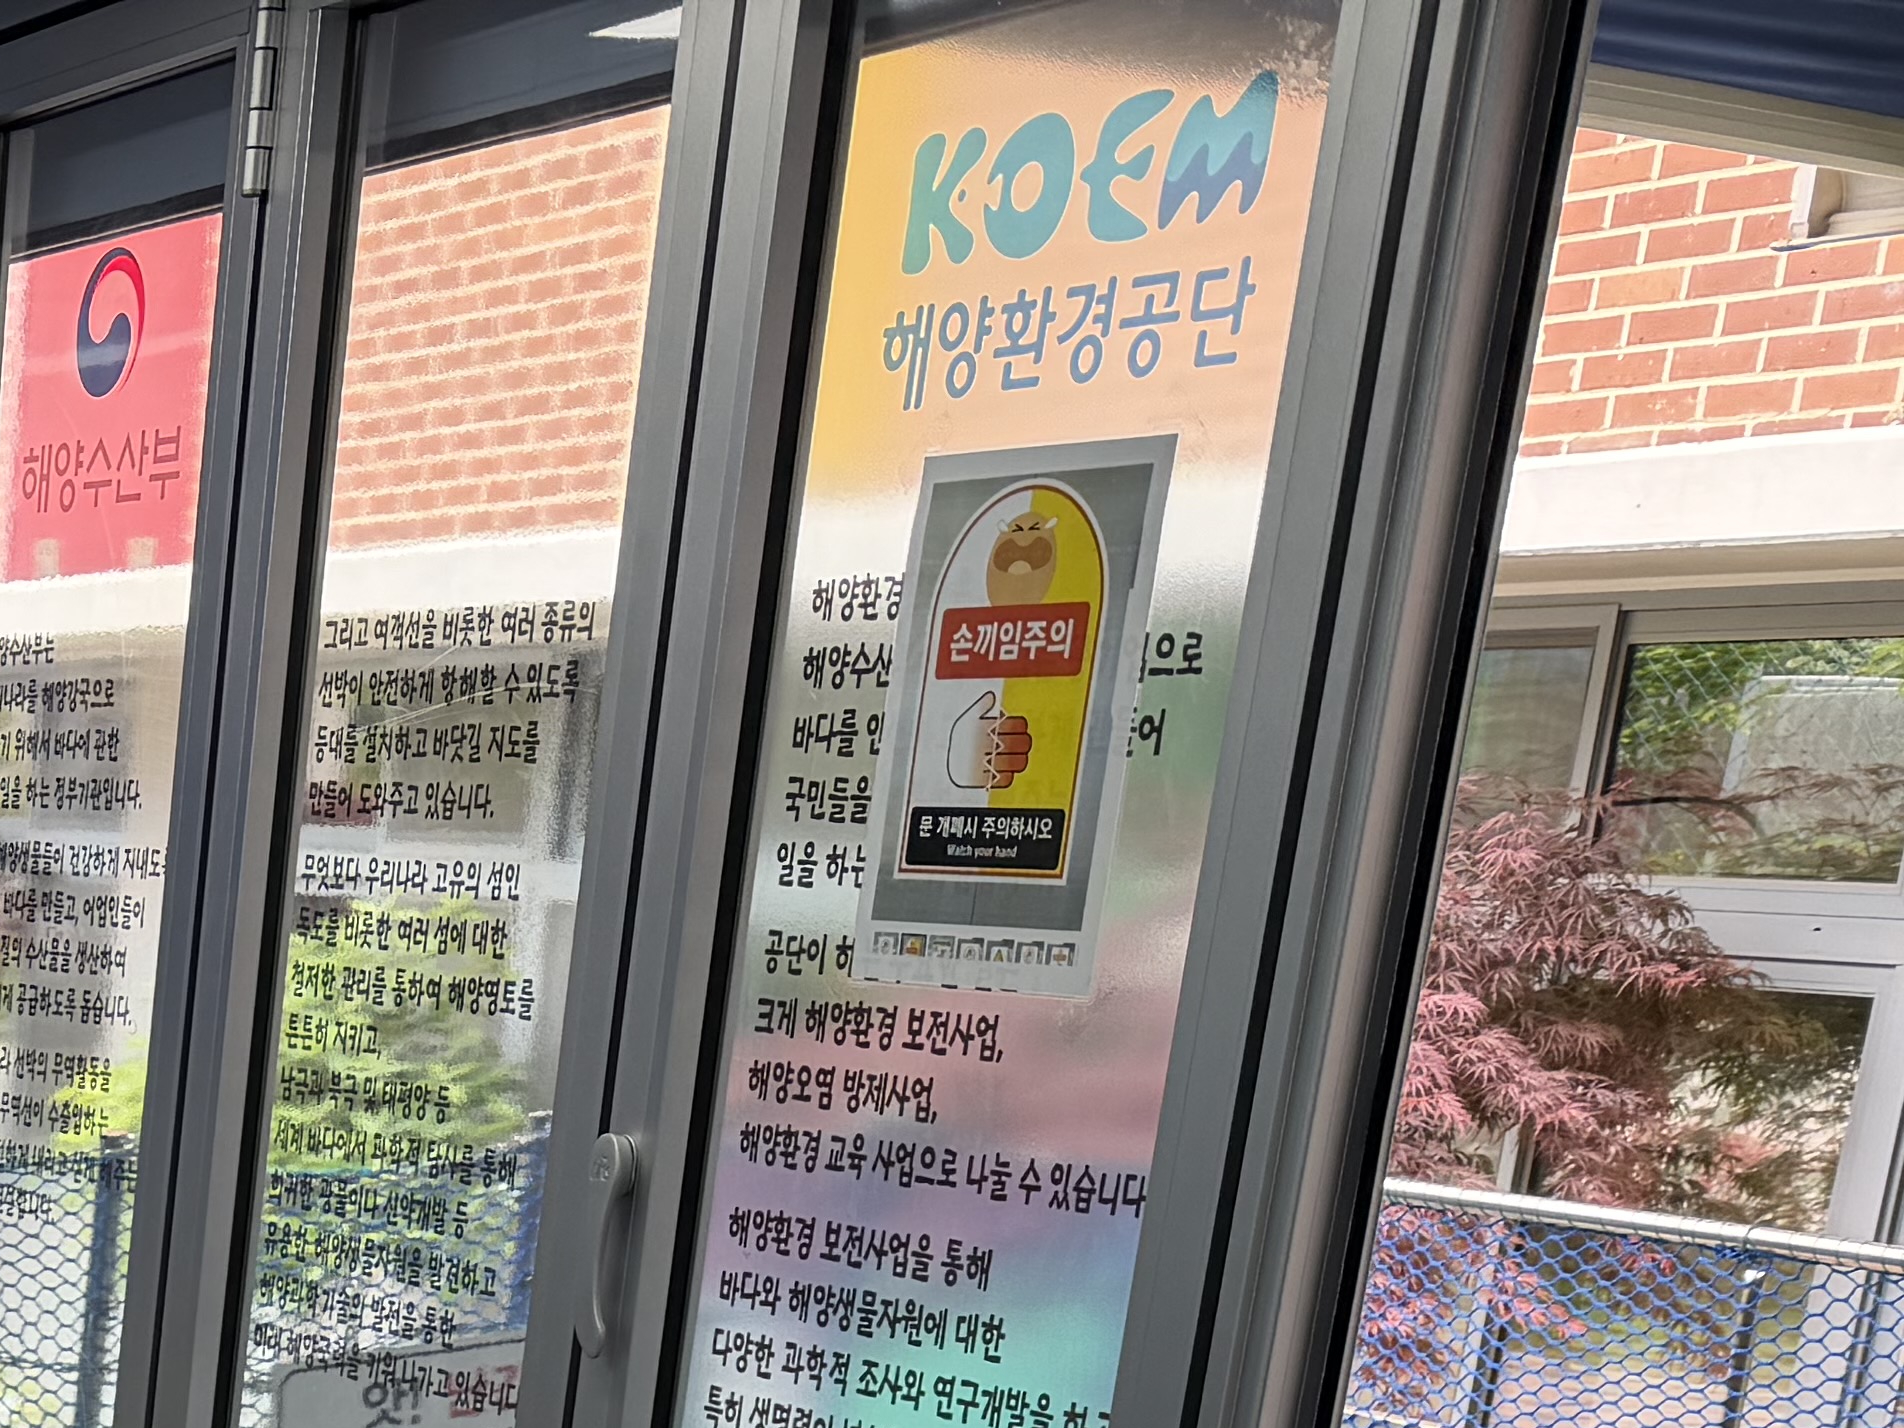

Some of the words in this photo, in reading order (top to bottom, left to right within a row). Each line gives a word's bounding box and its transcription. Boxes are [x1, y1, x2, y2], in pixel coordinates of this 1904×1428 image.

[901, 70, 1278, 275] KOEM
[883, 257, 1257, 411] 해양환경공단
[22, 426, 181, 513] 해양수산부
[324, 618, 368, 650] 그리고
[374, 609, 436, 650] 여객선을
[443, 605, 494, 648] 비롯한
[501, 606, 535, 644] 여러
[541, 600, 596, 644] 종류의
[950, 617, 1075, 663] 손끼임주의
[42, 678, 114, 712] 해양강국으로
[319, 669, 363, 708] 선박이
[369, 668, 434, 707] 안전하게
[441, 663, 496, 706] 항해할
[504, 663, 520, 705] 수
[526, 659, 580, 705] 있도록
[15, 728, 50, 761] 위해서
[55, 728, 89, 759] 바다에
[94, 727, 120, 762] 관한
[314, 723, 359, 764] 등대를
[363, 724, 428, 764] 설치하고
[433, 722, 482, 762] 바닷길
[488, 721, 540, 764] 지도를
[792, 709, 858, 757] 바다를
[0, 775, 21, 809] 일을
[26, 776, 50, 808] 하는
[54, 776, 142, 810] 정부기관입니다.
[309, 780, 352, 818] 만들어
[357, 781, 419, 819] 도와주고
[425, 781, 494, 821] 있습니다.
[786, 776, 871, 824] 국민들을
[919, 815, 933, 837] 문
[937, 815, 978, 839] 개폐시
[981, 816, 1053, 840] 주의하시오
[69, 844, 119, 877] 건강하게
[301, 854, 361, 891] 무엇보다
[365, 857, 428, 895] 우리나라
[432, 861, 481, 900] 고유의
[487, 861, 521, 901] 섬인
[777, 841, 818, 888] 일을
[4, 888, 37, 922] 바다를
[41, 890, 78, 926] 만들고,
[83, 894, 145, 930] 어업인들이
[295, 906, 340, 948] 독도를
[344, 910, 392, 951] 비롯한
[398, 914, 429, 953] 여러
[434, 916, 466, 956] 섬에
[472, 918, 508, 959] 대한
[26, 935, 73, 973] 수산물을
[75, 940, 127, 978] 생산하여
[765, 930, 827, 976] 공단이
[17, 983, 76, 1022] 공급하도록
[80, 988, 132, 1026] 돕습니다.
[291, 960, 335, 1001] 철저한
[341, 965, 387, 1006] 관리를
[392, 968, 441, 1010] 통하여
[448, 973, 534, 1021] 해양영토를
[284, 1013, 328, 1052] 튼튼히
[333, 1020, 382, 1059] 지키고,
[754, 997, 798, 1040] 크게
[804, 998, 898, 1051] 해양환경
[902, 1007, 1004, 1064] 보전사업,
[14, 1047, 48, 1083] 선박의
[52, 1052, 112, 1092] 무역활동을
[748, 1059, 836, 1111] 해양오염
[843, 1069, 939, 1124] 방제사업,
[0, 1092, 44, 1127] 무역선이
[382, 1078, 431, 1121] 태평양
[434, 1085, 451, 1124] 등
[275, 1118, 303, 1154] 세계
[308, 1123, 368, 1166] 바다에서
[371, 1132, 421, 1175] 과학적
[426, 1140, 475, 1186] 탐사를
[480, 1147, 517, 1191] 통해
[739, 1122, 822, 1173] 해양환경
[824, 1134, 867, 1180] 교육
[871, 1141, 958, 1189] 사업으로
[966, 1153, 1012, 1202] 나눌
[1018, 1158, 1043, 1208] 수
[1049, 1163, 1147, 1219] 있습니다
[383, 1192, 449, 1238] 신약개발
[453, 1200, 469, 1239] 등
[264, 1221, 307, 1263] 유용한
[316, 1231, 424, 1287] 해양생물자원을
[429, 1252, 496, 1297] 발견하고
[728, 1206, 816, 1261] 해양환경
[820, 1220, 934, 1283] 보전사업을
[941, 1238, 993, 1292] 통해
[371, 1295, 417, 1340] 발전을
[422, 1305, 456, 1350] 통한
[719, 1270, 781, 1316] 바다와
[788, 1281, 948, 1350] 해양생물자원에
[955, 1313, 1006, 1364] 대한
[711, 1327, 774, 1380] 다양한
[781, 1340, 852, 1398] 과학적
[856, 1359, 925, 1411] 조사와
